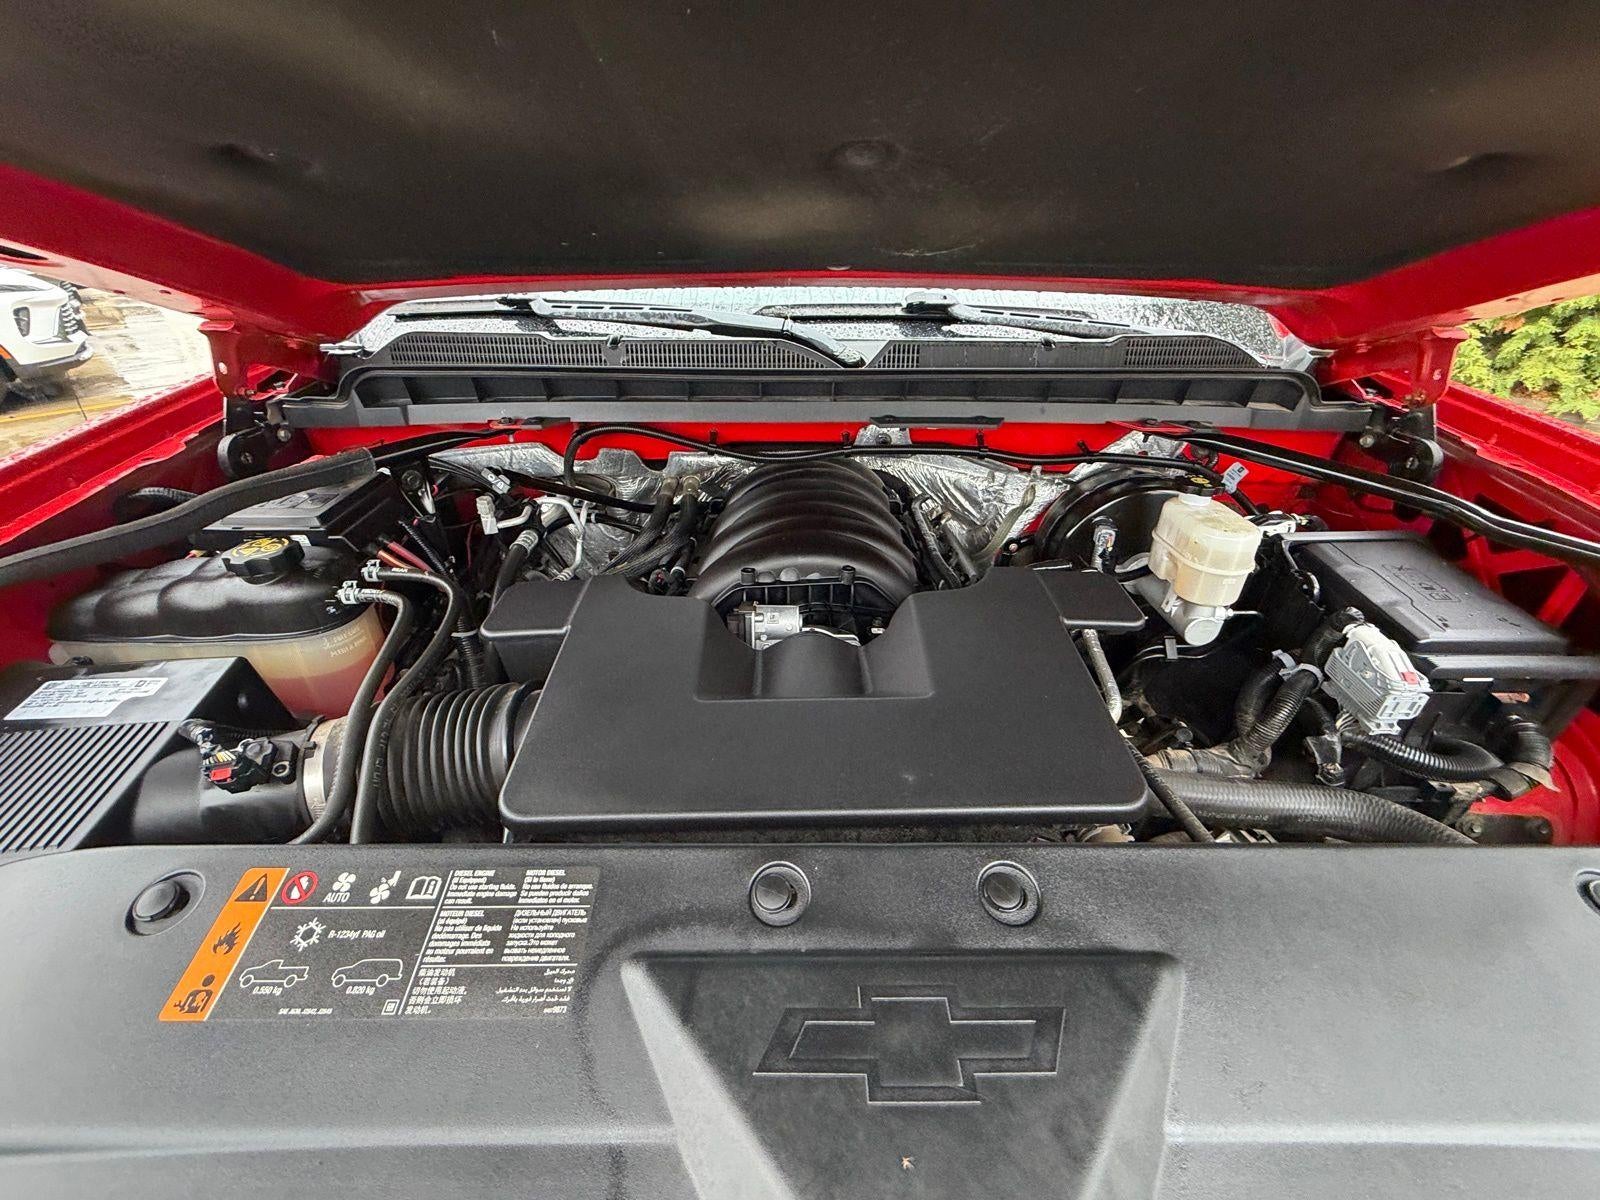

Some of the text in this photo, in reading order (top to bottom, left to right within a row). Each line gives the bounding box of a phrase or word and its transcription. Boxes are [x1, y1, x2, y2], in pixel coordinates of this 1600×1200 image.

[322, 892, 350, 903] AUTO
[328, 930, 386, 940] R-1234yf PAG oil
[273, 986, 283, 996] kg
[366, 986, 375, 995] kg
